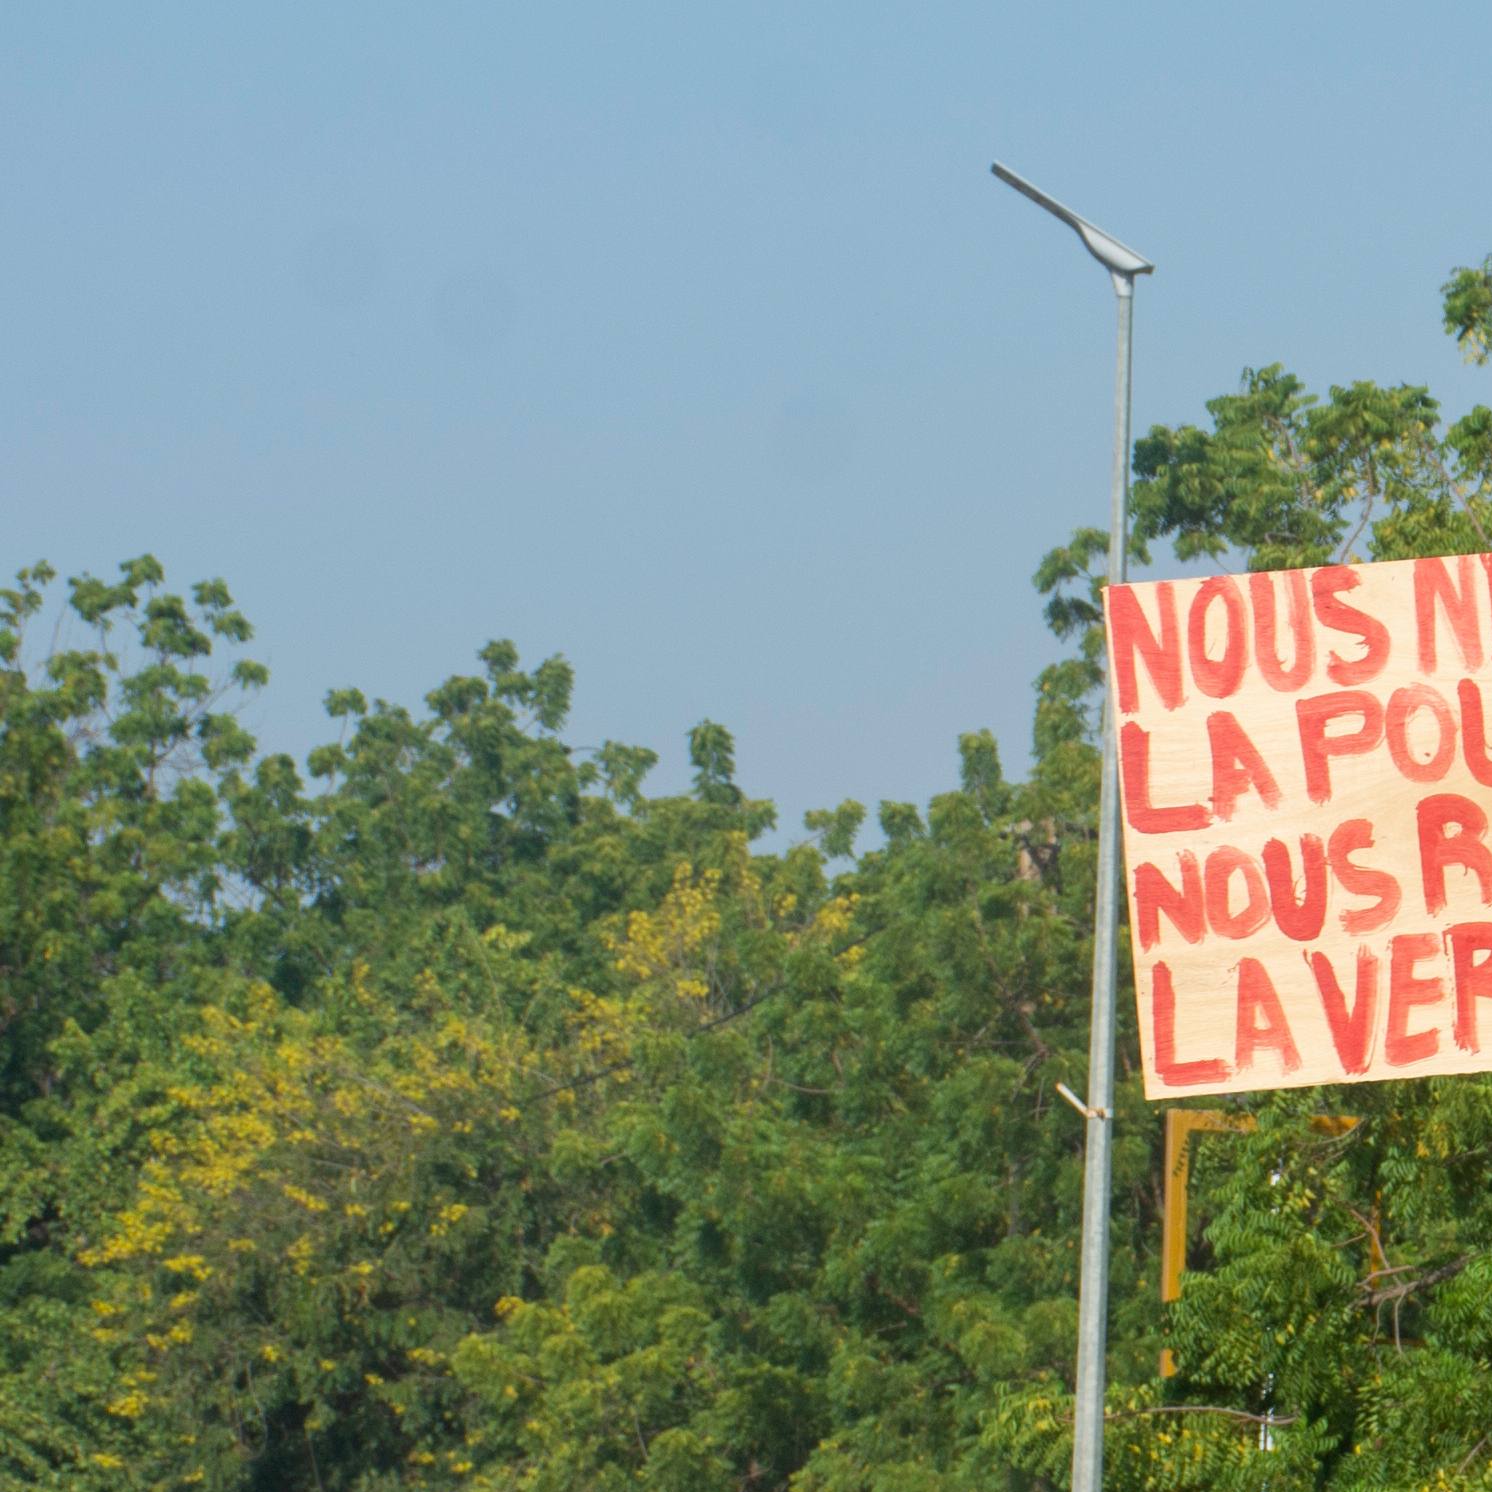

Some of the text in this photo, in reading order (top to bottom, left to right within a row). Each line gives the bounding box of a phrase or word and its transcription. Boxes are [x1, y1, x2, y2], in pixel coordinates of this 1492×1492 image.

[1108, 566, 1391, 714] NOUS
[1120, 710, 1284, 835] LA
[1134, 818, 1402, 953] NOUS
[1152, 957, 1302, 1086] LA
